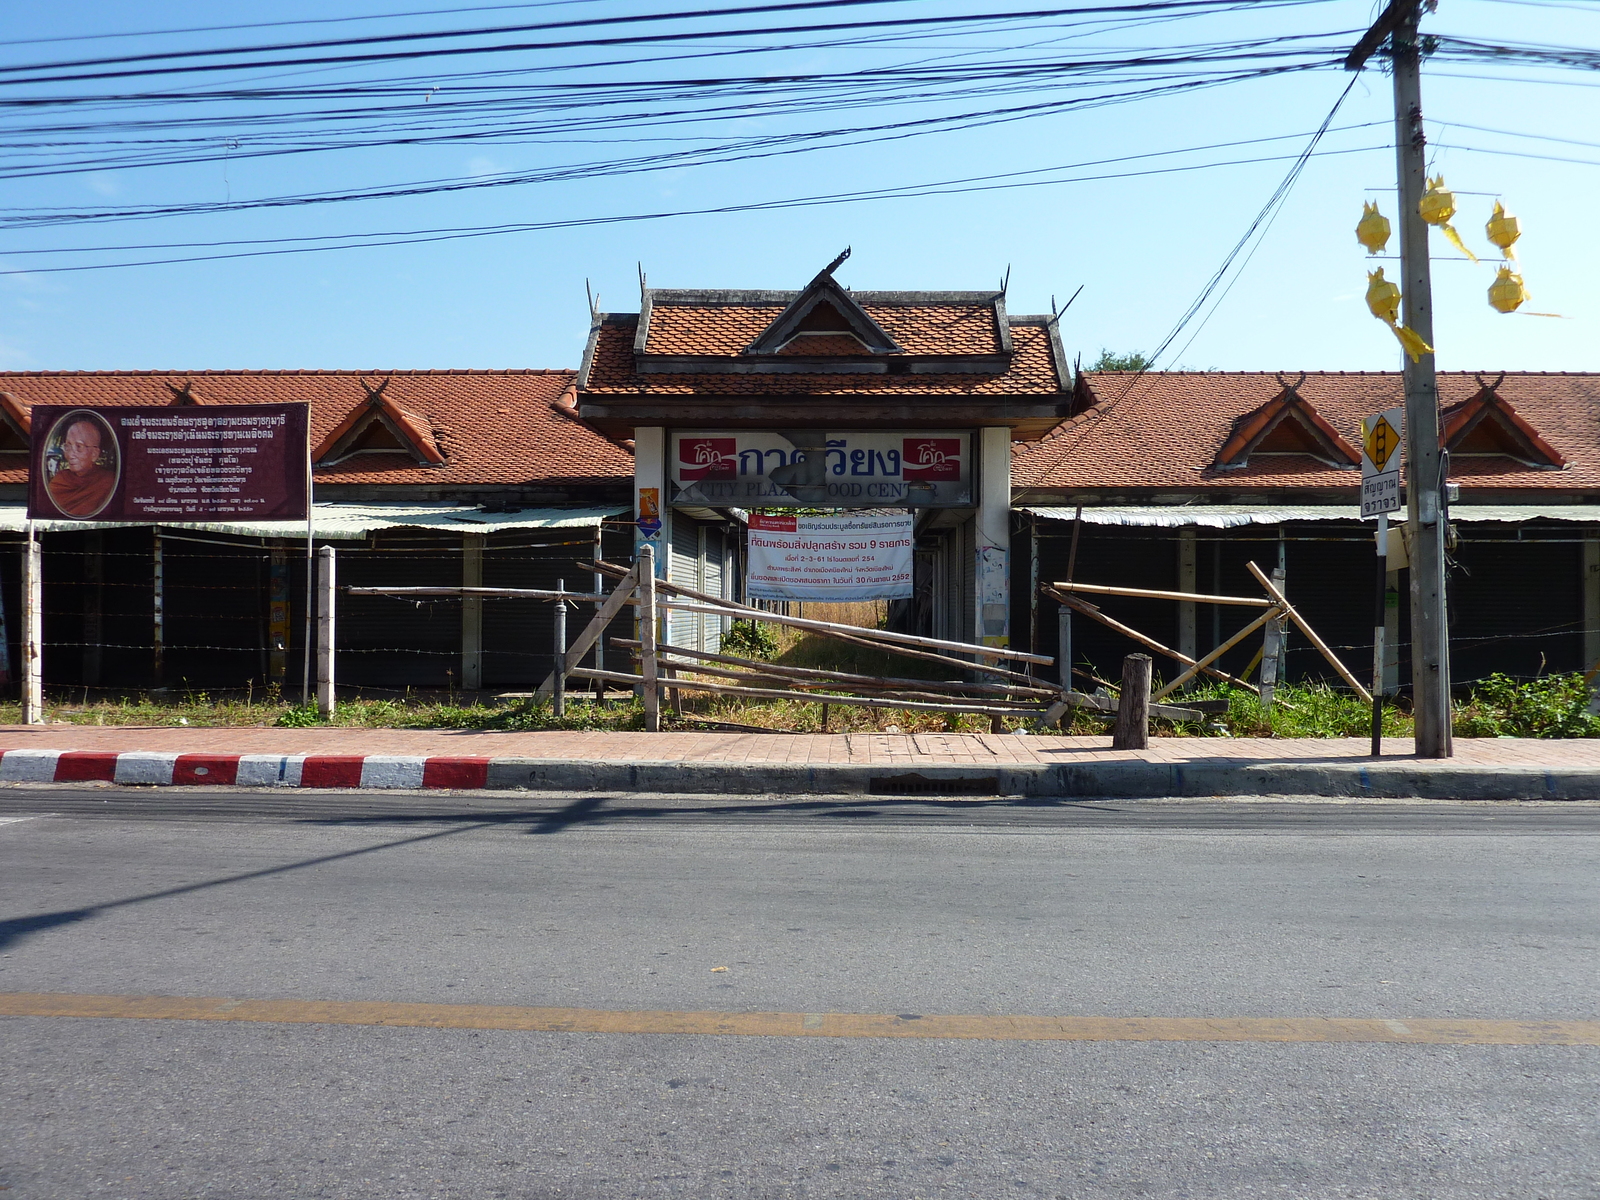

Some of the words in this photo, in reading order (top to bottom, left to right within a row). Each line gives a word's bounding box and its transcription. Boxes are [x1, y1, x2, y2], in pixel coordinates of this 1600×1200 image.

[699, 482, 737, 497] CITY
[821, 483, 862, 497] OOD
[1364, 479, 1397, 498] สัญญาณ
[1364, 496, 1397, 512] จราจร
[751, 534, 847, 552] ที่ดินพร้อมสิ่งปลูกสร้าง
[848, 542, 867, 550] รวม
[869, 540, 877, 549] 9
[878, 538, 911, 549] รายการ
[855, 576, 866, 584] 30
[892, 573, 910, 582] 2552
